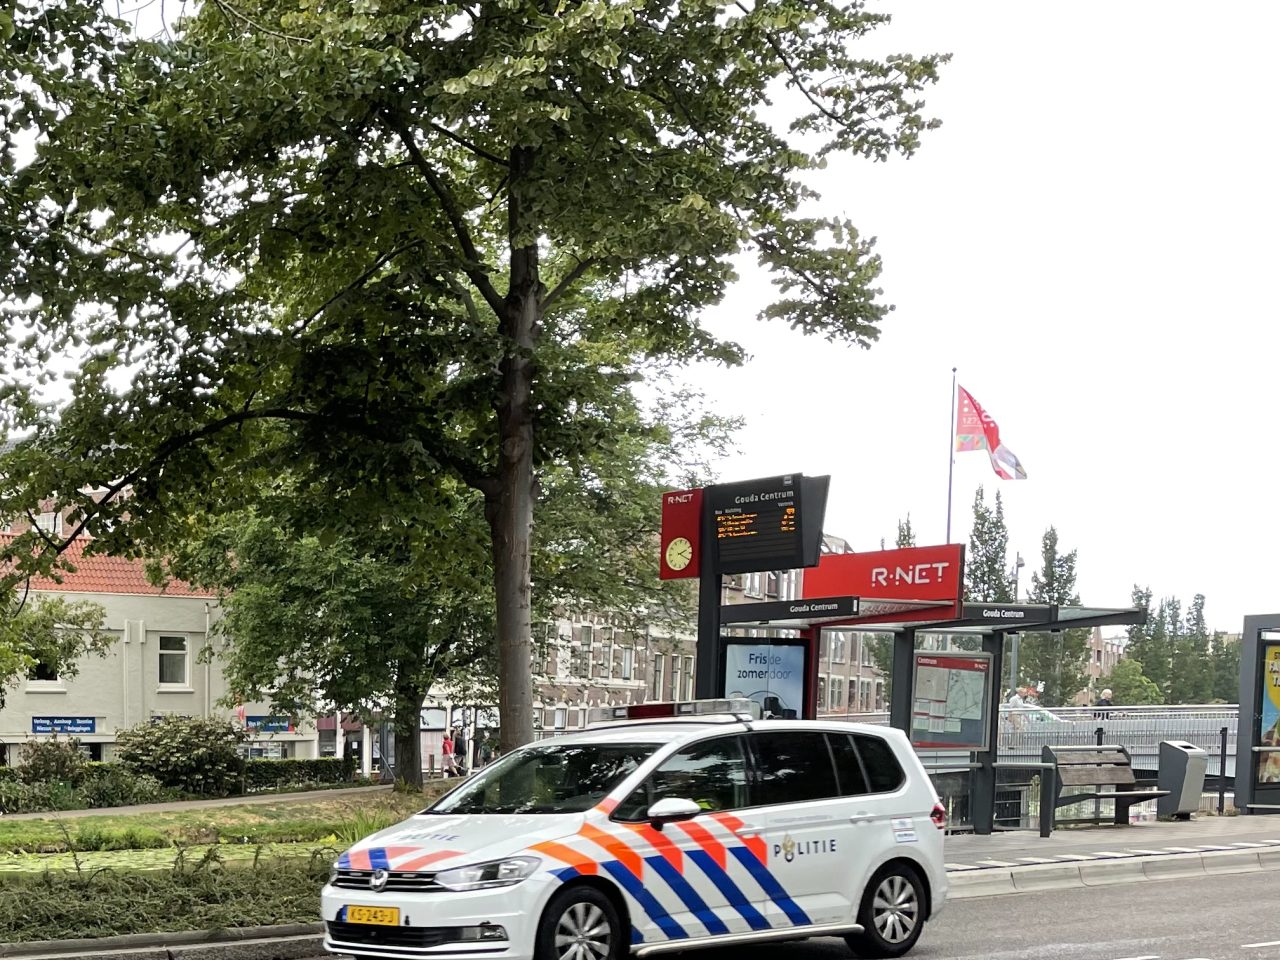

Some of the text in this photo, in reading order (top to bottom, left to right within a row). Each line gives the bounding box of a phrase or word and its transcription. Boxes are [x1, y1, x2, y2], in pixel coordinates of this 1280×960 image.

[735, 490, 794, 504] Gouda Centrum
[789, 603, 839, 613] Gouda Centrum
[982, 609, 1025, 618] Gouda Centrum
[748, 653, 782, 665] Fris de
[737, 669, 792, 680] zomer door
[774, 838, 837, 862] POLITIE
